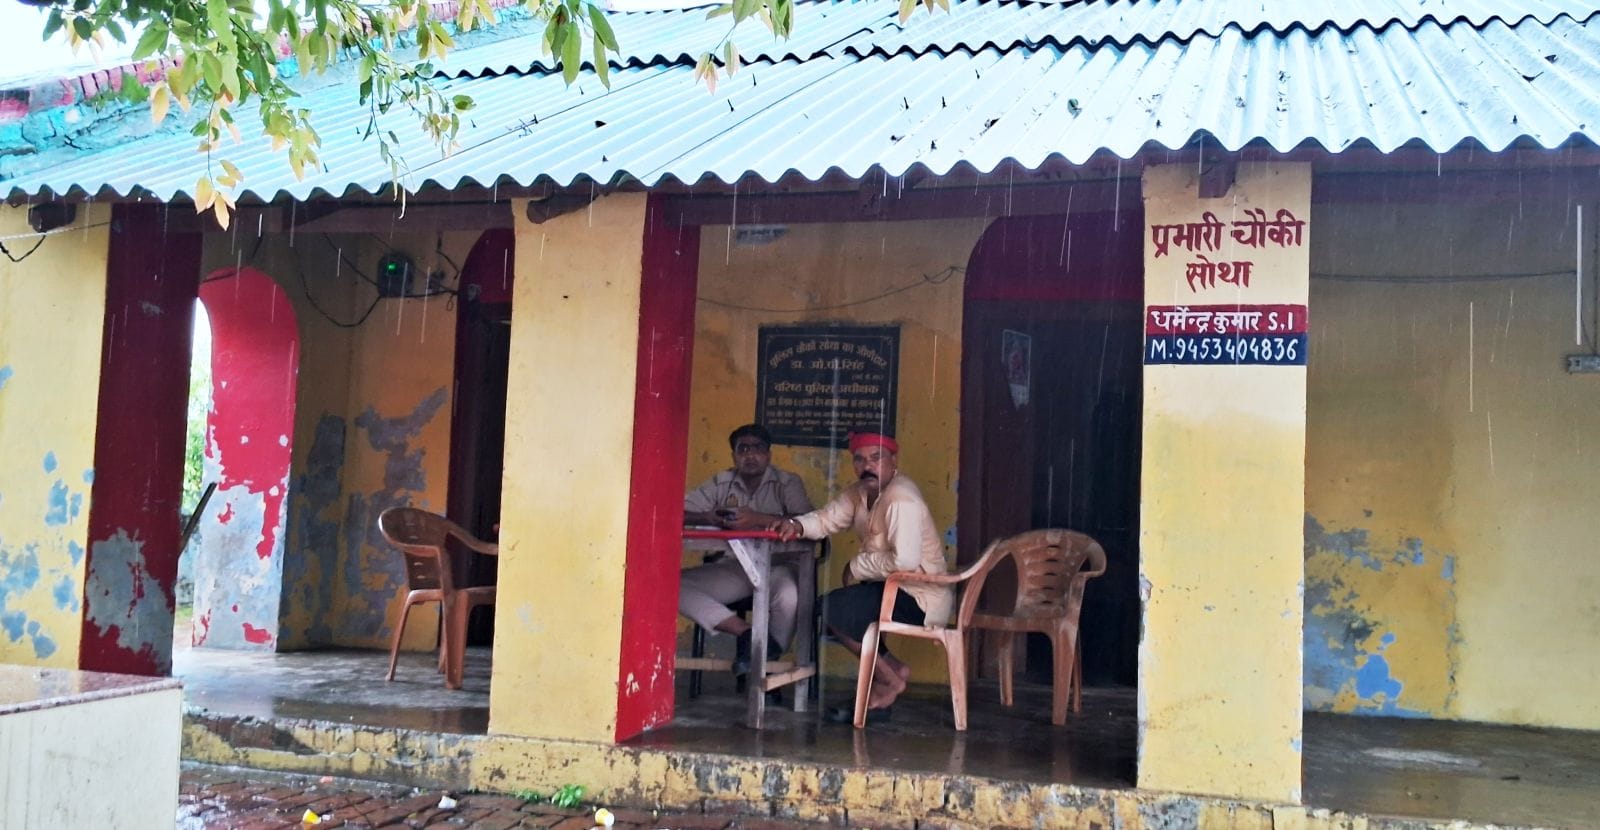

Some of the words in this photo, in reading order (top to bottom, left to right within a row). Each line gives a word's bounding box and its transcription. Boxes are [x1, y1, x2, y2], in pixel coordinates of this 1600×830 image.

[1151, 211, 1226, 258] प्रभारी
[1231, 208, 1305, 248] चौकी
[1186, 254, 1254, 293] सोथा
[1213, 311, 1262, 333] कुमार
